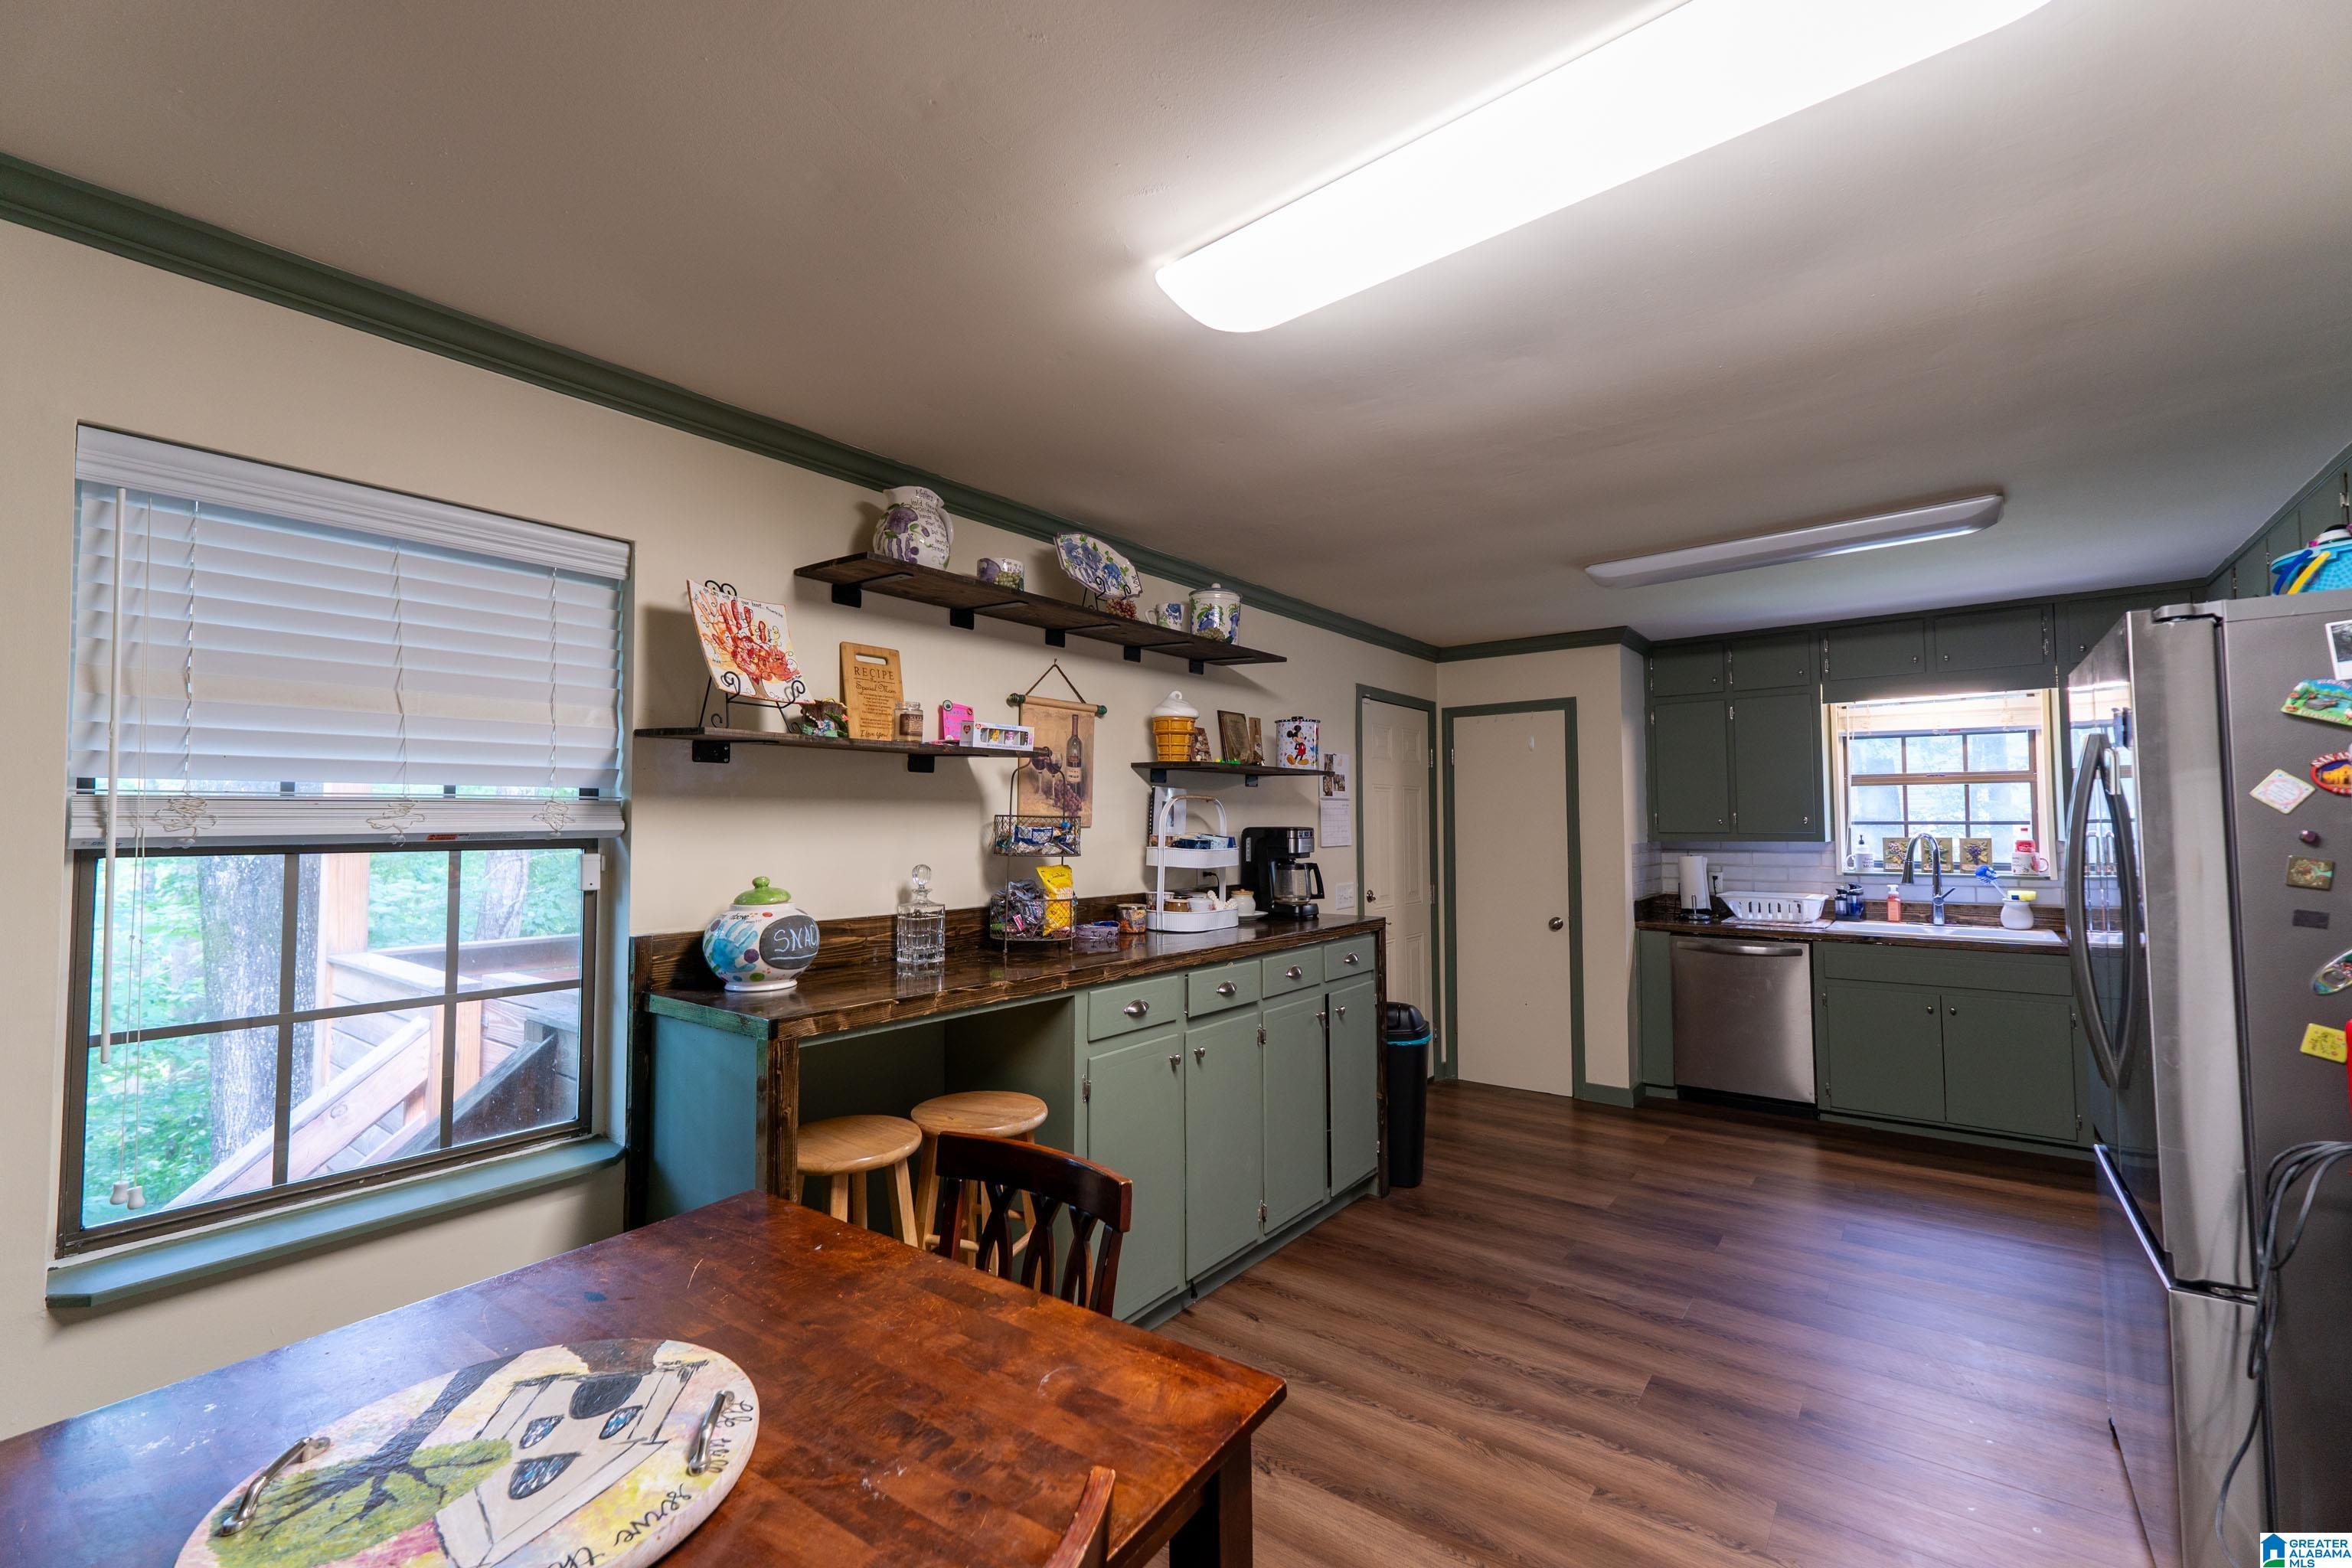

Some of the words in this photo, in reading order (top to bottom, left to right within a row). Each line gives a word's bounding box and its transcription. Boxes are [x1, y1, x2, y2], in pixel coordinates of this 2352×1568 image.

[854, 666, 895, 681] RECIPE
[855, 681, 877, 693] Special
[878, 683, 897, 694] Mom
[773, 920, 819, 952] SNAC
[612, 1482, 692, 1548] serve
